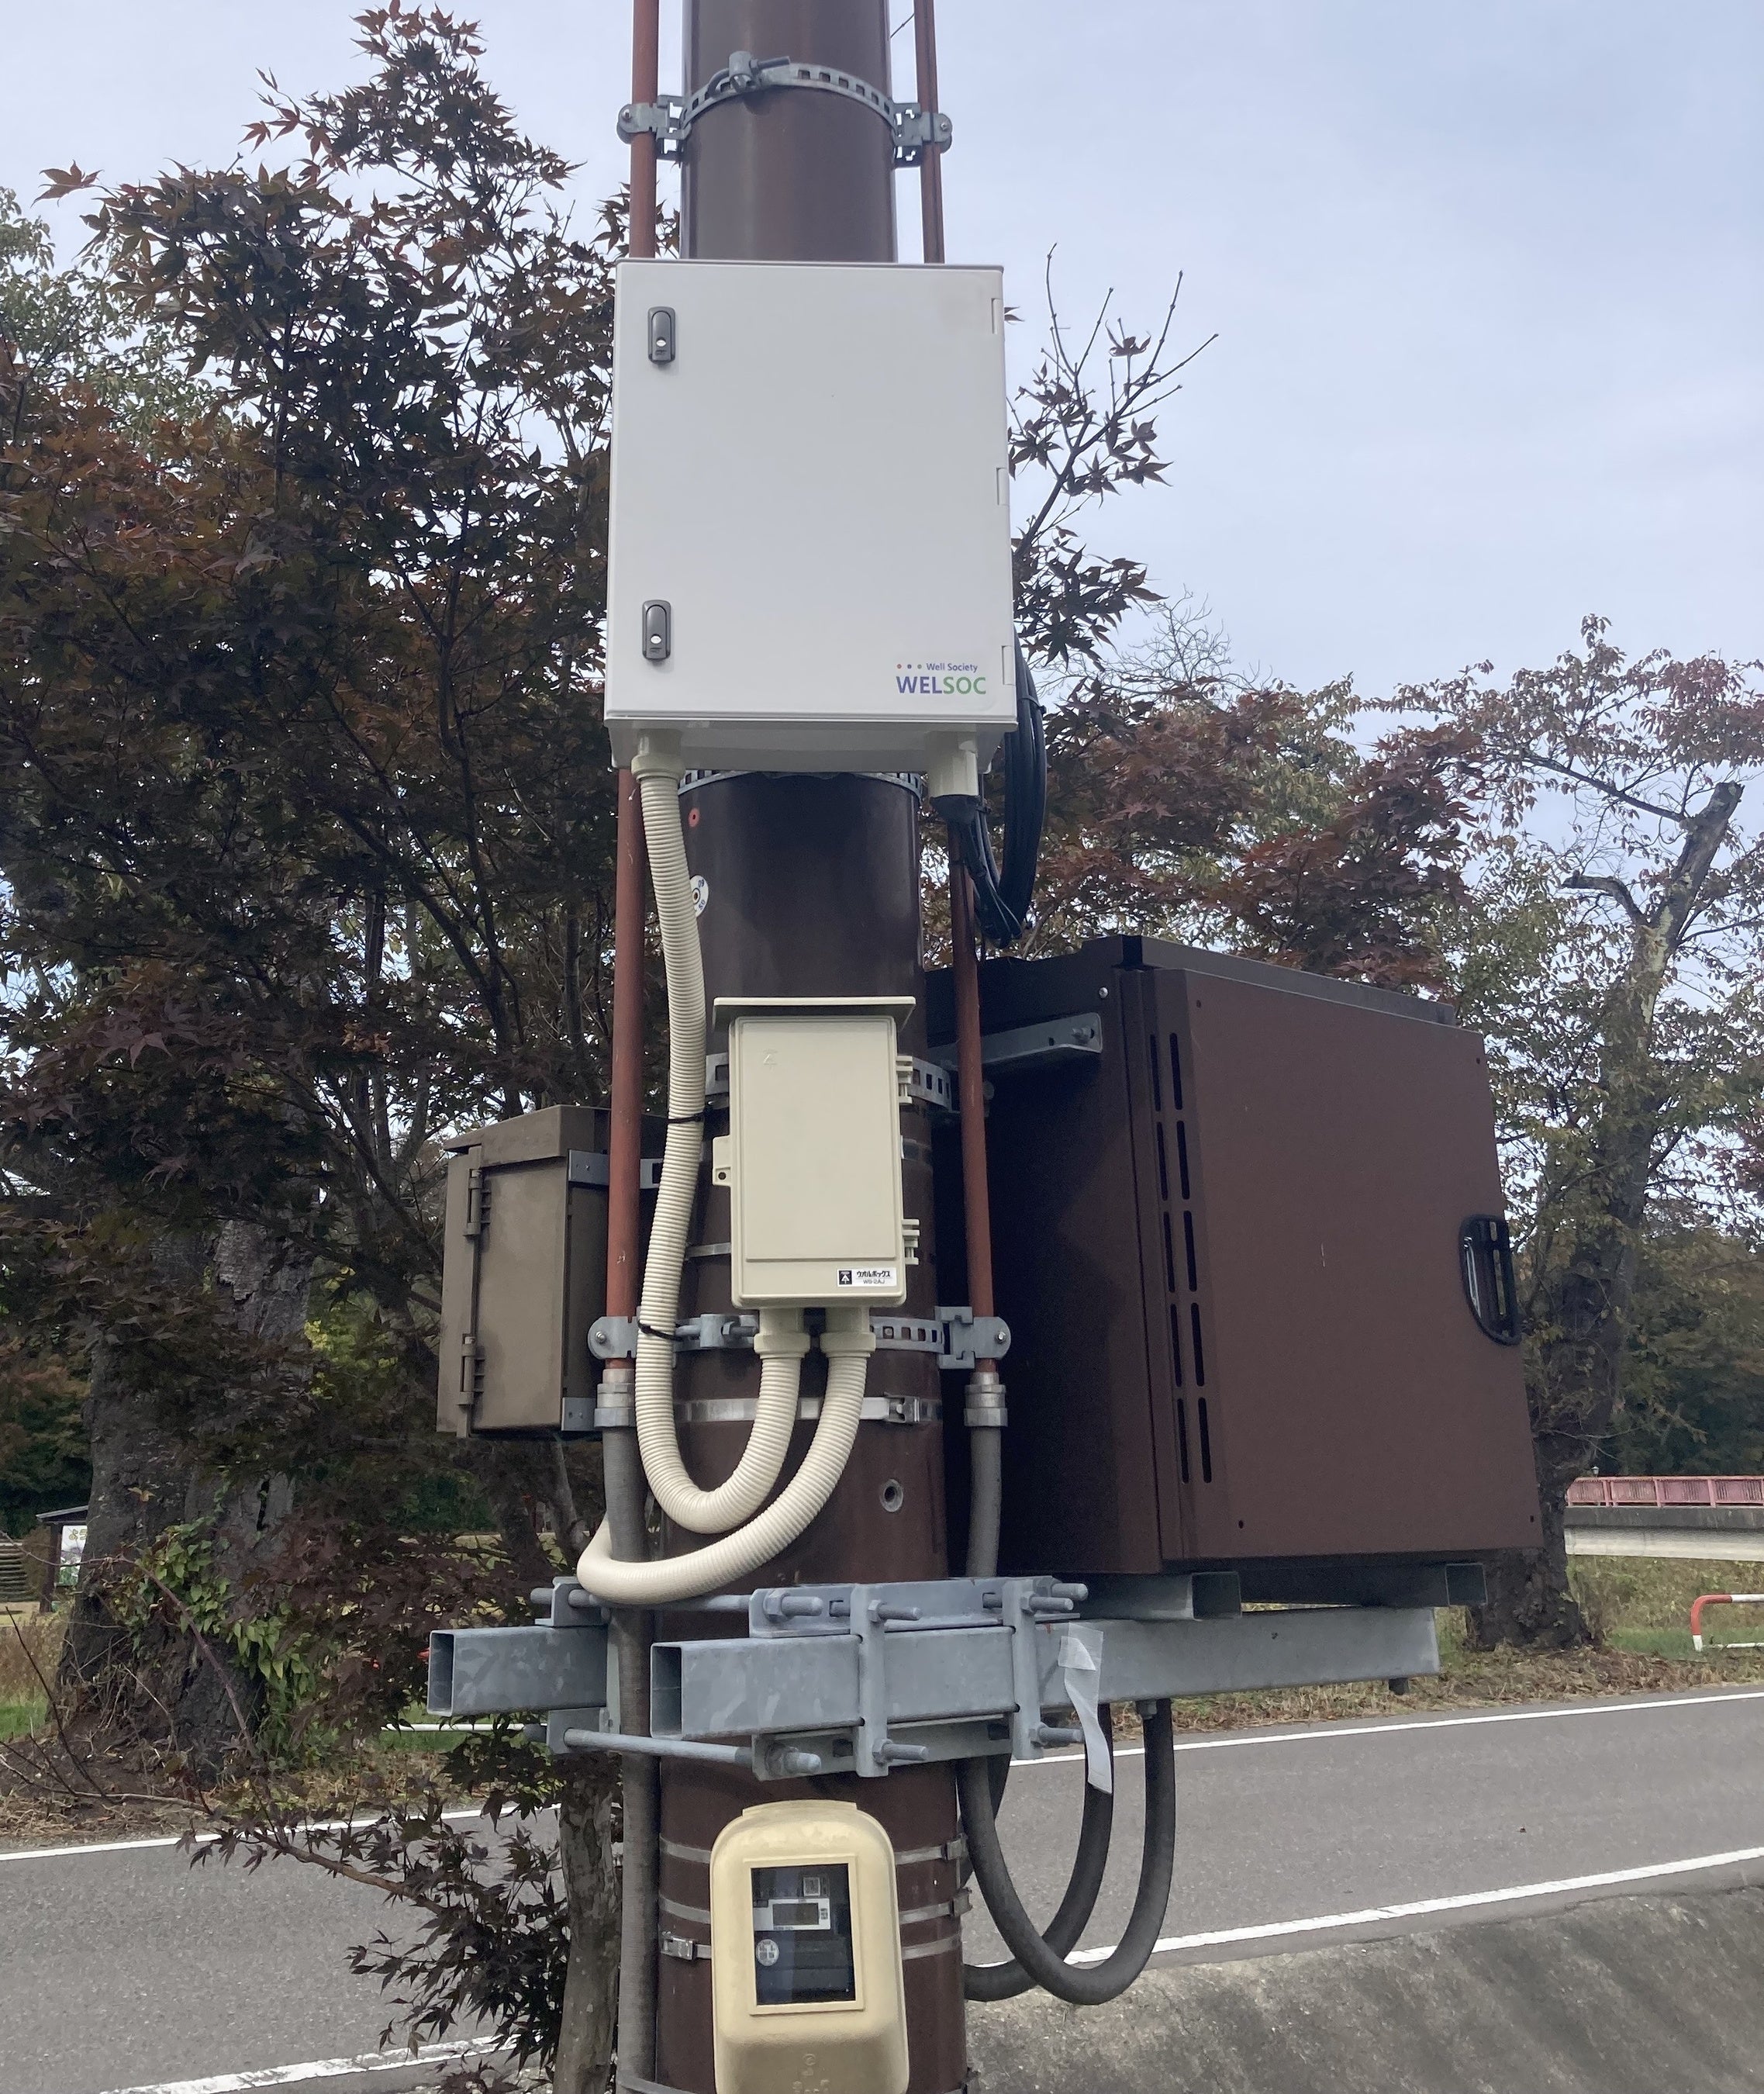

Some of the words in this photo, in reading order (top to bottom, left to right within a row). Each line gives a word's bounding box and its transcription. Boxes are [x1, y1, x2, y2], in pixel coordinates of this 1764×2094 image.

[926, 662, 945, 671] Well
[948, 662, 979, 673] Society
[896, 676, 986, 695] WELSOC
